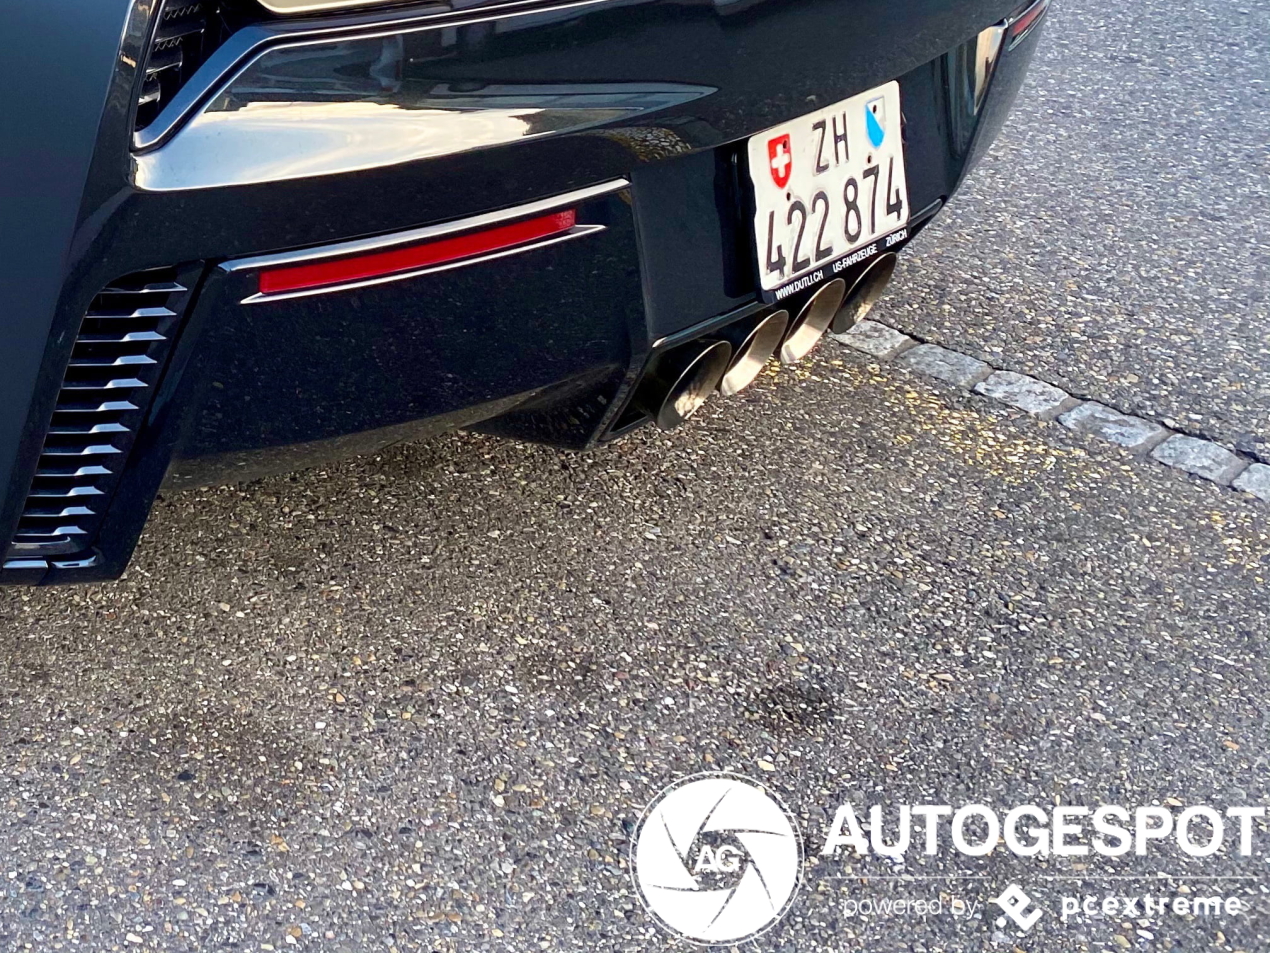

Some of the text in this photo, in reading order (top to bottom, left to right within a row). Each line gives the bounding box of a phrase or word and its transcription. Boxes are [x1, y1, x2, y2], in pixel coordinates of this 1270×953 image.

[812, 112, 849, 175] ZH
[766, 156, 903, 277] 422 874
[832, 243, 878, 273] US-FAHRZEUGE
[885, 228, 908, 247] ZÜRICH
